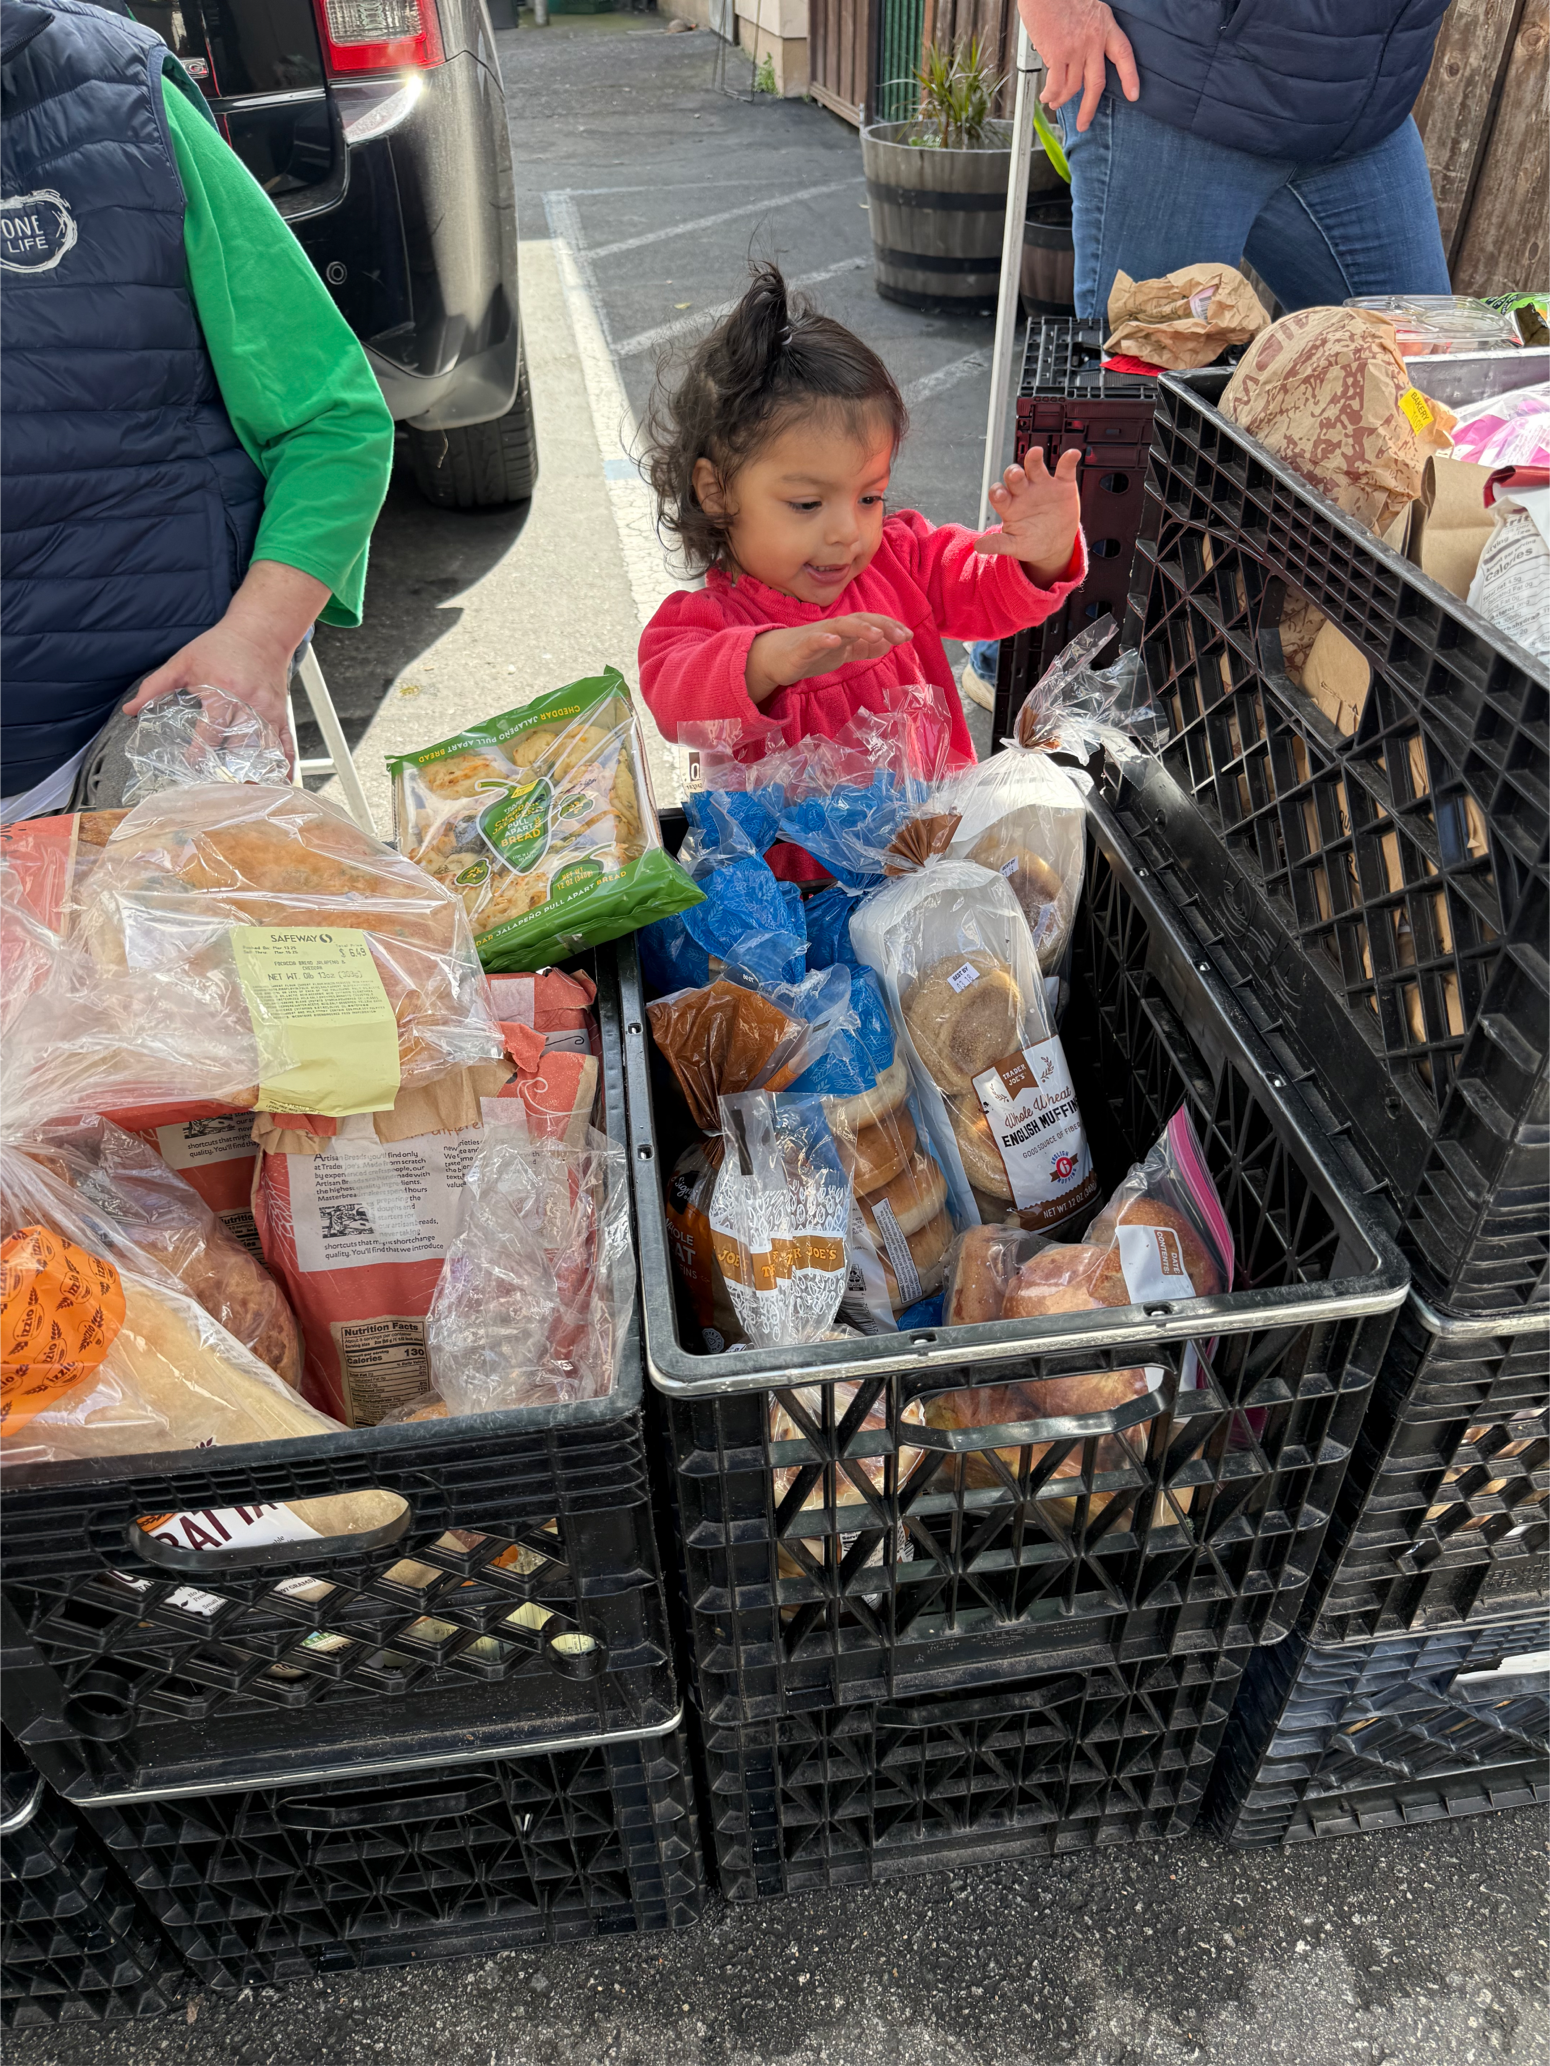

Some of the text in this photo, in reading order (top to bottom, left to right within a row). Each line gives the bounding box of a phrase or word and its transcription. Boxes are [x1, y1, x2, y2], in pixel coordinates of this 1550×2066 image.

[1, 215, 43, 239] ONE
[7, 236, 49, 253] LIFE
[1411, 391, 1429, 421] BAKERY
[1485, 547, 1533, 582] Calories
[418, 705, 581, 763] CHEDDAR JALAPEÑO PULL APART BREAD
[505, 823, 534, 838] APART
[507, 818, 530, 829] PULL
[501, 829, 541, 847] BREAD
[496, 871, 627, 937] JALAPEÑO PULL APART BREAD
[270, 934, 318, 943] SAFEWAY
[348, 947, 367, 957] 6.49
[267, 972, 282, 981] NET
[286, 972, 301, 980] WT.
[1002, 1063, 1026, 1080] TRADER
[1004, 1086, 1071, 1129] Whole Wheat
[1001, 1096, 1079, 1147] ENGLISH MUFFIN
[187, 1139, 218, 1150] shortcuts
[233, 1141, 246, 1150] find
[1022, 1121, 1081, 1159] GOOD SOURCE OF FIBER
[314, 1153, 343, 1162] Artisan
[387, 1151, 401, 1159] find
[402, 1150, 418, 1159] only
[1059, 1160, 1068, 1174] 6
[314, 1172, 325, 1180] by
[315, 1179, 341, 1187] Artisan
[1043, 1207, 1057, 1219] NET
[1068, 1198, 1077, 1208] 12
[221, 1214, 253, 1225] utritio
[324, 1241, 358, 1250] shortcuts
[393, 1235, 436, 1245] shortchange
[325, 1251, 351, 1261] quality.
[372, 1246, 385, 1254] find
[385, 1246, 400, 1254] that
[411, 1243, 444, 1252] introduce
[717, 1249, 741, 1267] JOE
[806, 1246, 837, 1260] JOE'S
[1157, 1231, 1170, 1274] CONTENTS:
[1171, 1252, 1181, 1274] DATE:
[63, 1274, 81, 1297] izzio
[16, 1308, 34, 1338] izzio
[344, 1321, 419, 1337] Nutrition Facts
[347, 1348, 425, 1365] Calories 130
